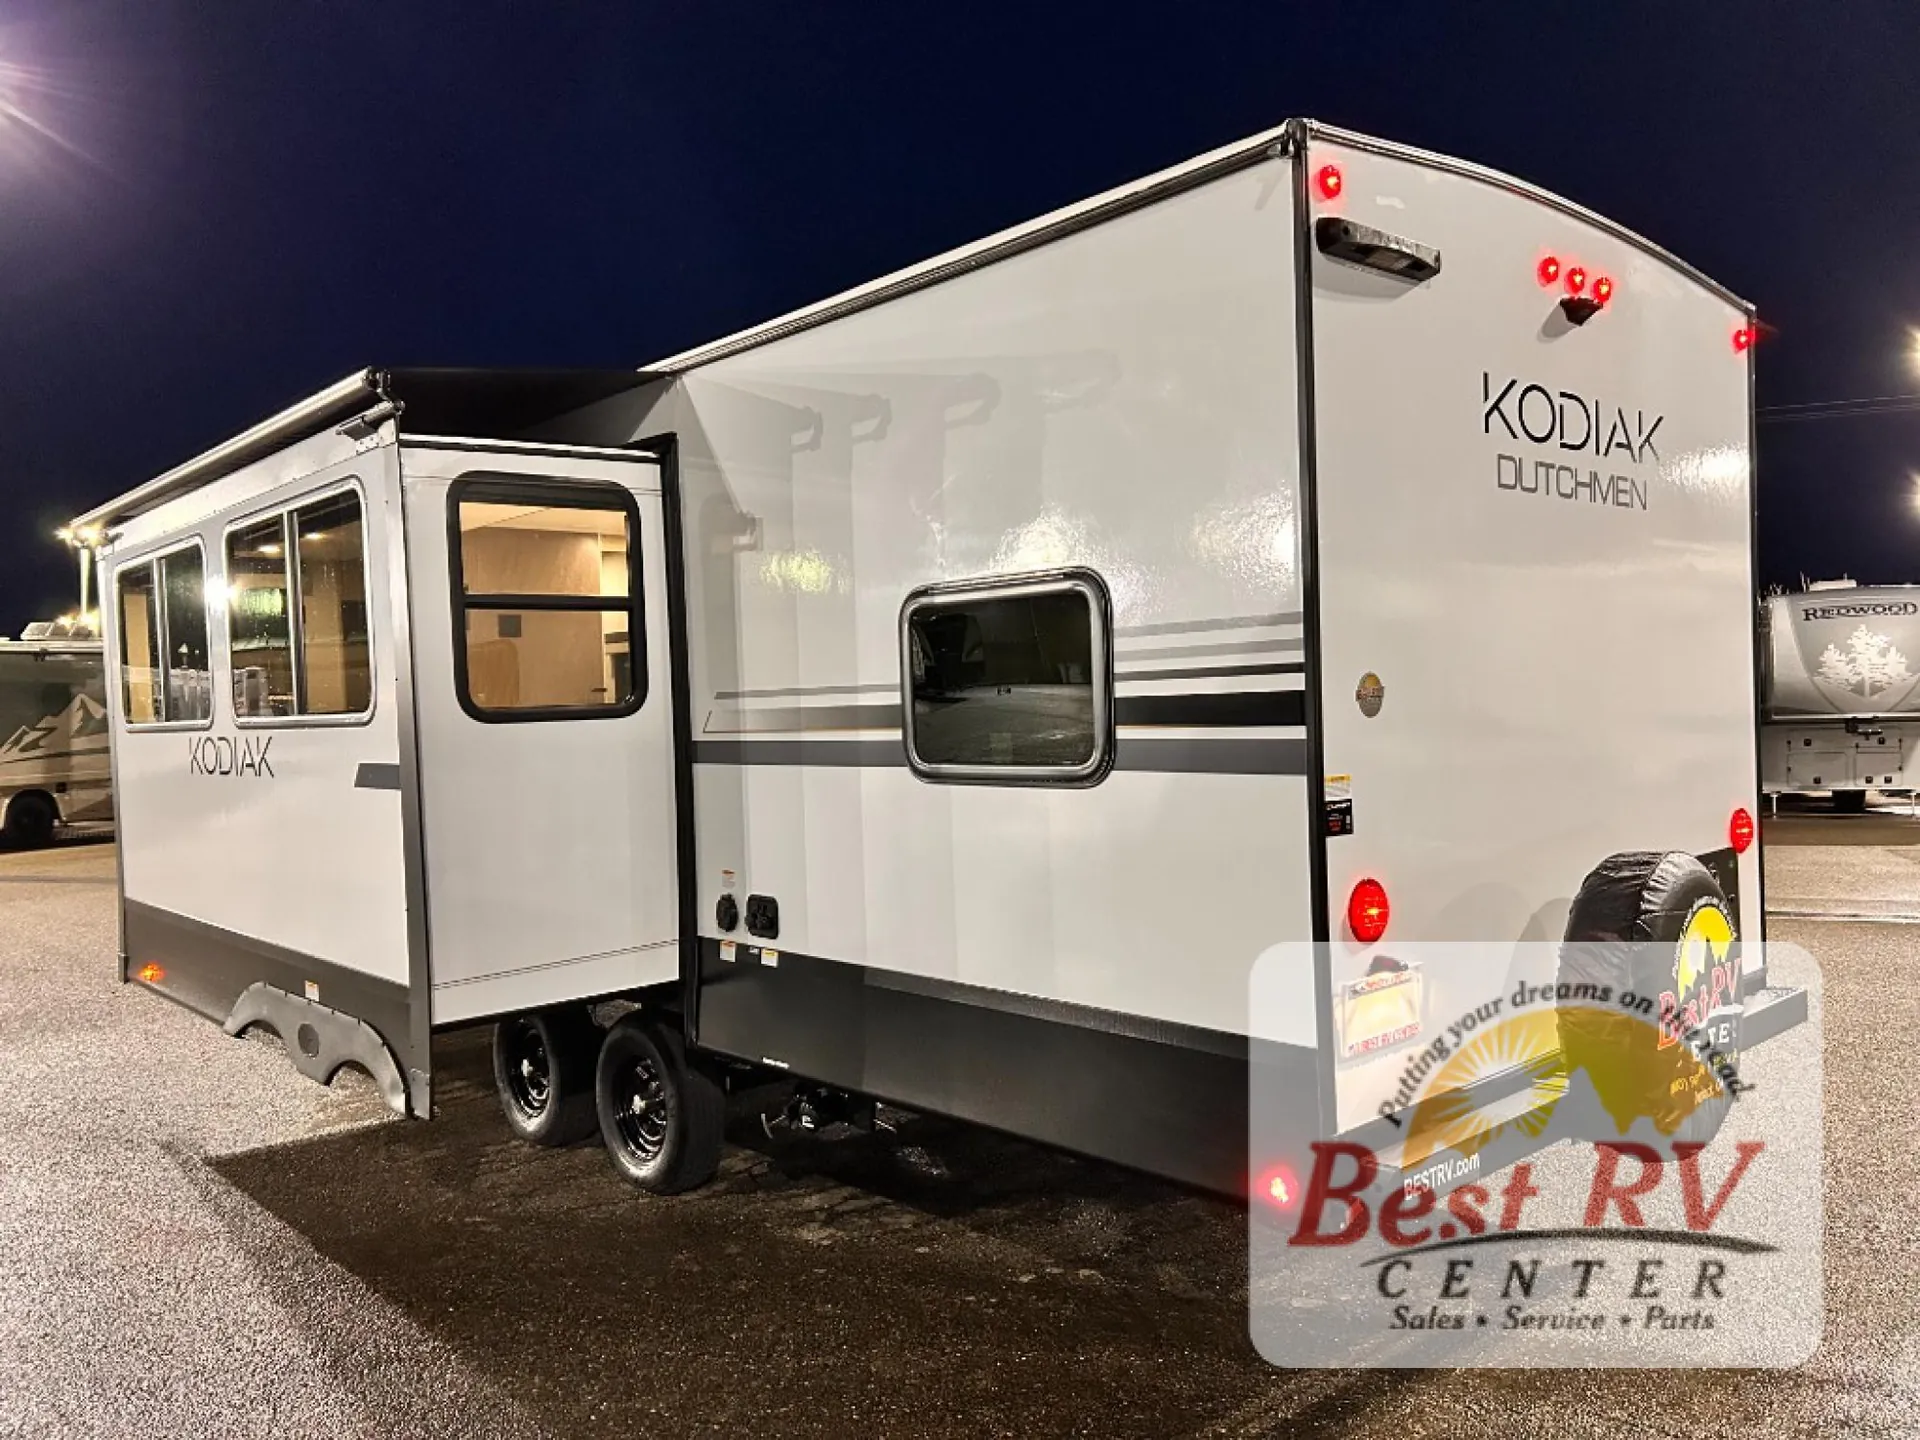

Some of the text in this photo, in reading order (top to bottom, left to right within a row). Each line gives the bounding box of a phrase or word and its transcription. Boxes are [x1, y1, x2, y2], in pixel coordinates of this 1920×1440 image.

[1482, 371, 1664, 465] KODIAK
[1497, 453, 1648, 511] DUTCHMEN
[1802, 600, 1919, 622] REDWOOD
[189, 735, 275, 779] KODIAK
[1403, 1152, 1481, 1201] BESTRV.com
